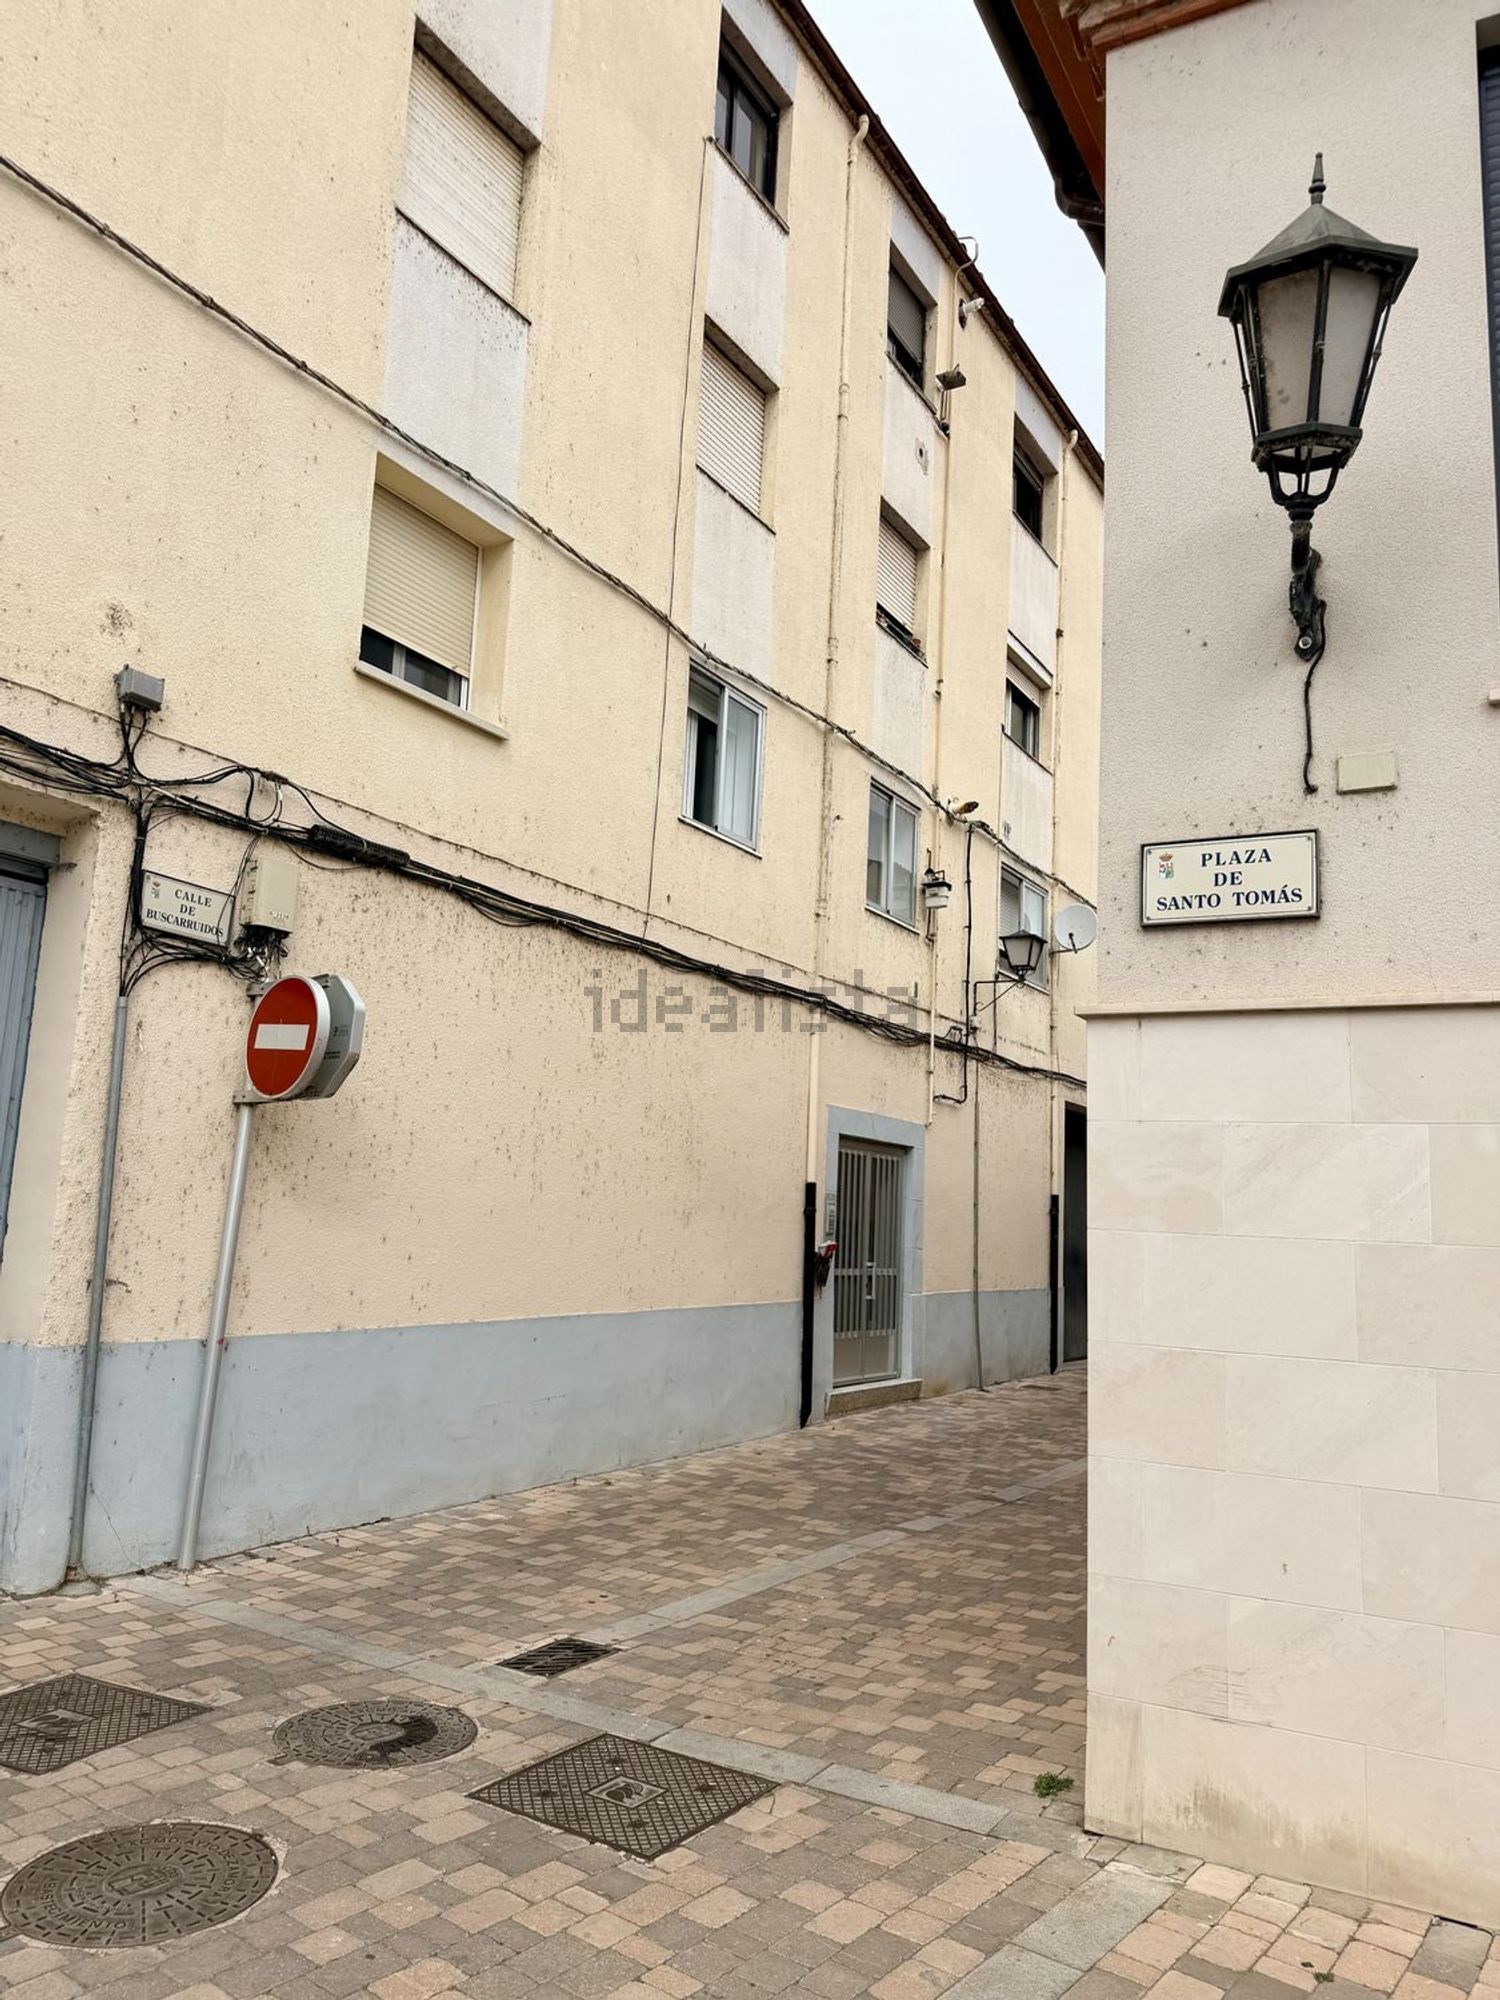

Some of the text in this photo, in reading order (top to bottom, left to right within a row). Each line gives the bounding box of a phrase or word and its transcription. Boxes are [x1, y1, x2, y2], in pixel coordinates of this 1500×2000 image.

[1200, 849, 1272, 867] PLAZA
[1214, 871, 1243, 887] DE
[174, 888, 213, 908] CALLE
[1156, 884, 1303, 911] SANTO TOMÁS
[179, 904, 196, 917] DE
[146, 908, 224, 937] BUSCARRUIDOS
